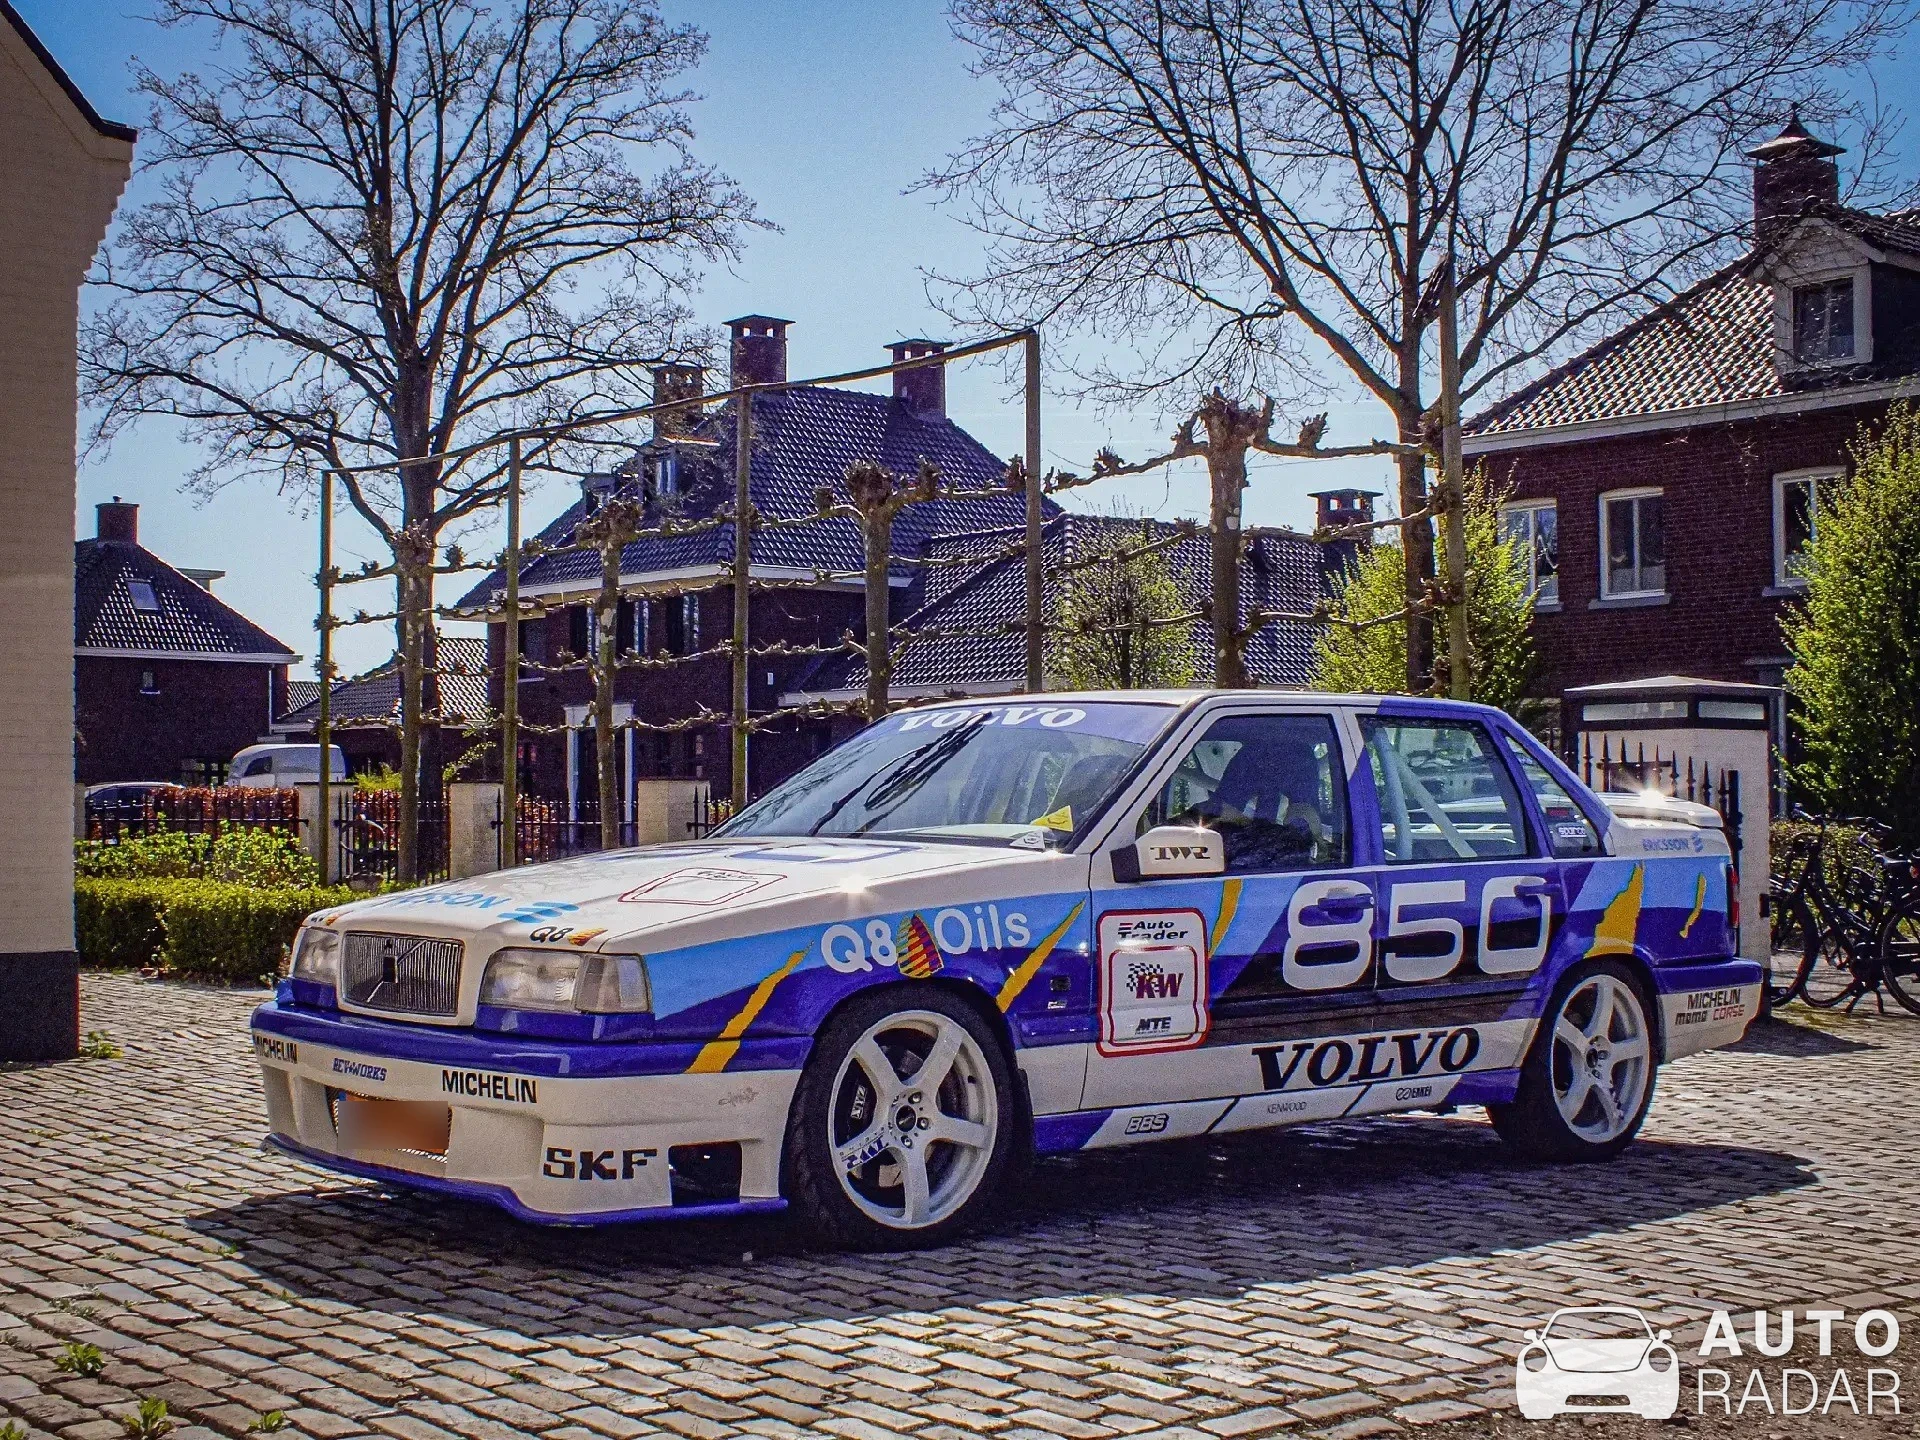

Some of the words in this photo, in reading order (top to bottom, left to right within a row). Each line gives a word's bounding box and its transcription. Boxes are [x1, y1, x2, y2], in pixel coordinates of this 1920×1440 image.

[1150, 846, 1210, 860] TWR
[529, 926, 574, 943] Q8
[1118, 930, 1188, 940] Trader
[1134, 921, 1174, 930] Auto
[1282, 876, 1551, 990] 850
[819, 919, 898, 973] Q8
[933, 904, 1031, 955] Oils
[1688, 989, 1741, 1009] MICHELIN
[1713, 1004, 1745, 1020] CORSE
[1251, 1028, 1480, 1091] VOLVO
[442, 1069, 537, 1104] MICHELIN
[1267, 1102, 1307, 1114] KENWOOD
[1125, 1113, 1169, 1134] BBS
[543, 1148, 658, 1181] SKF
